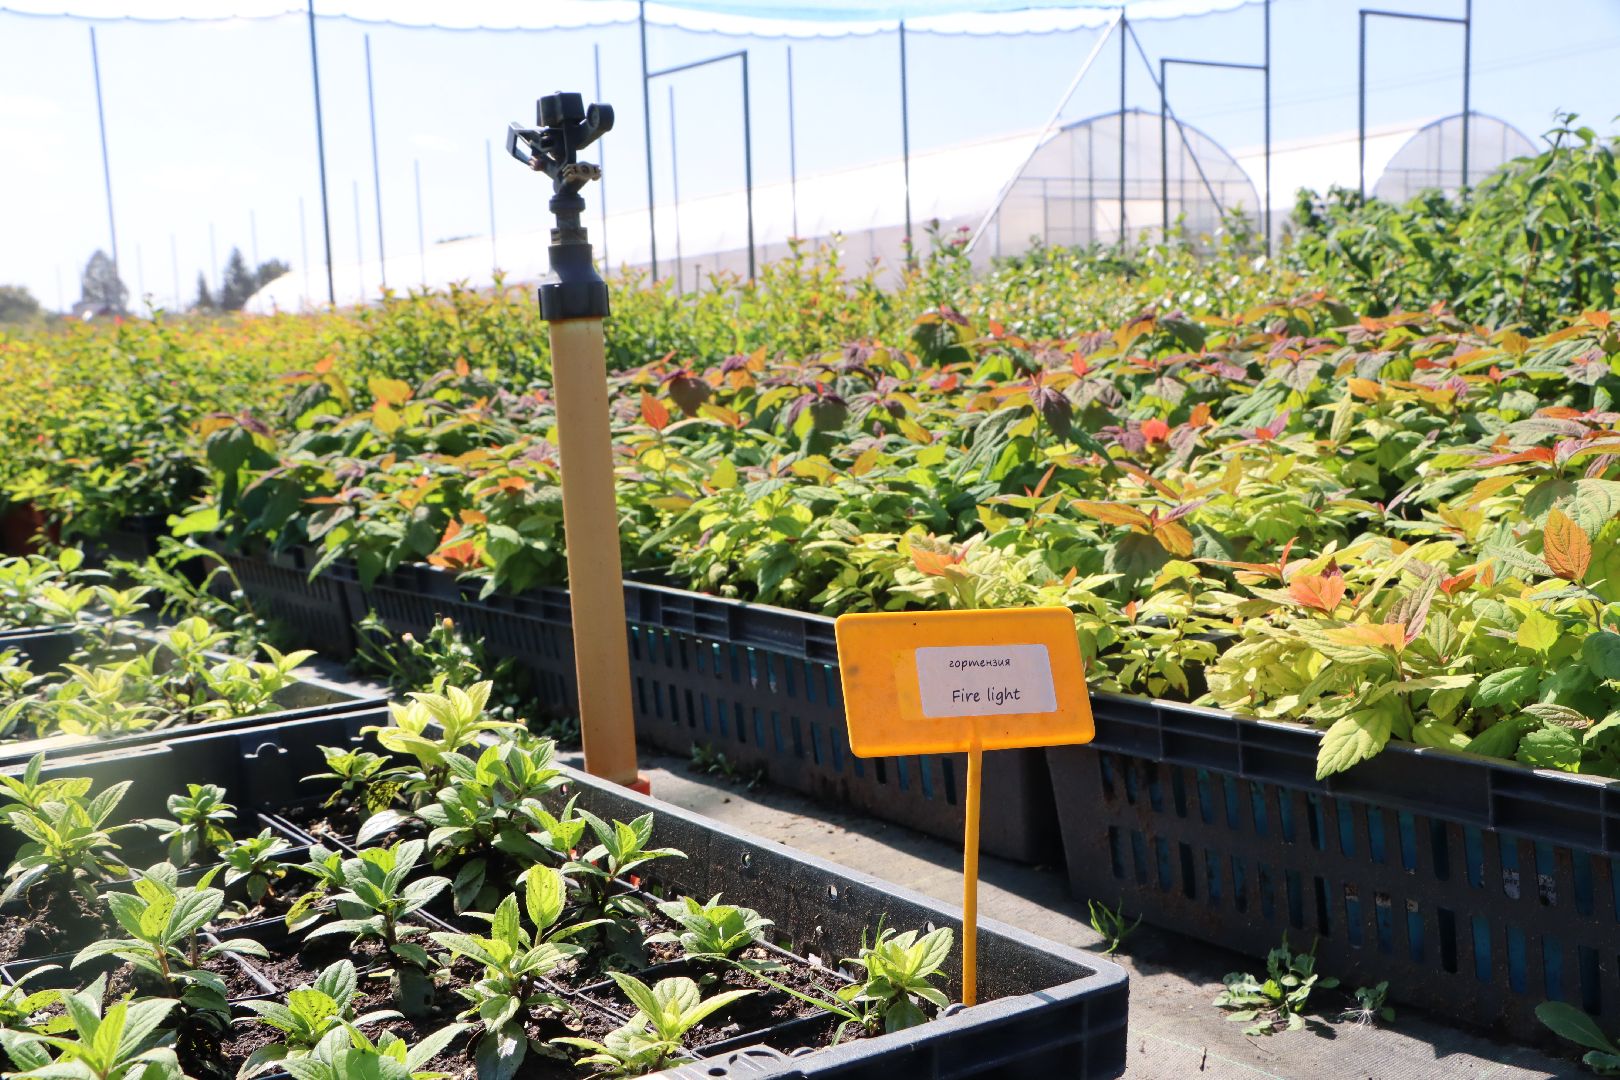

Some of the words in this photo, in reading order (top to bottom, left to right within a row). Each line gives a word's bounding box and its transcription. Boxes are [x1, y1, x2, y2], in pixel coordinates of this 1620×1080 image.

[949, 658, 1011, 671] гортензия
[952, 688, 981, 703] Fire
[987, 686, 1021, 706] light
